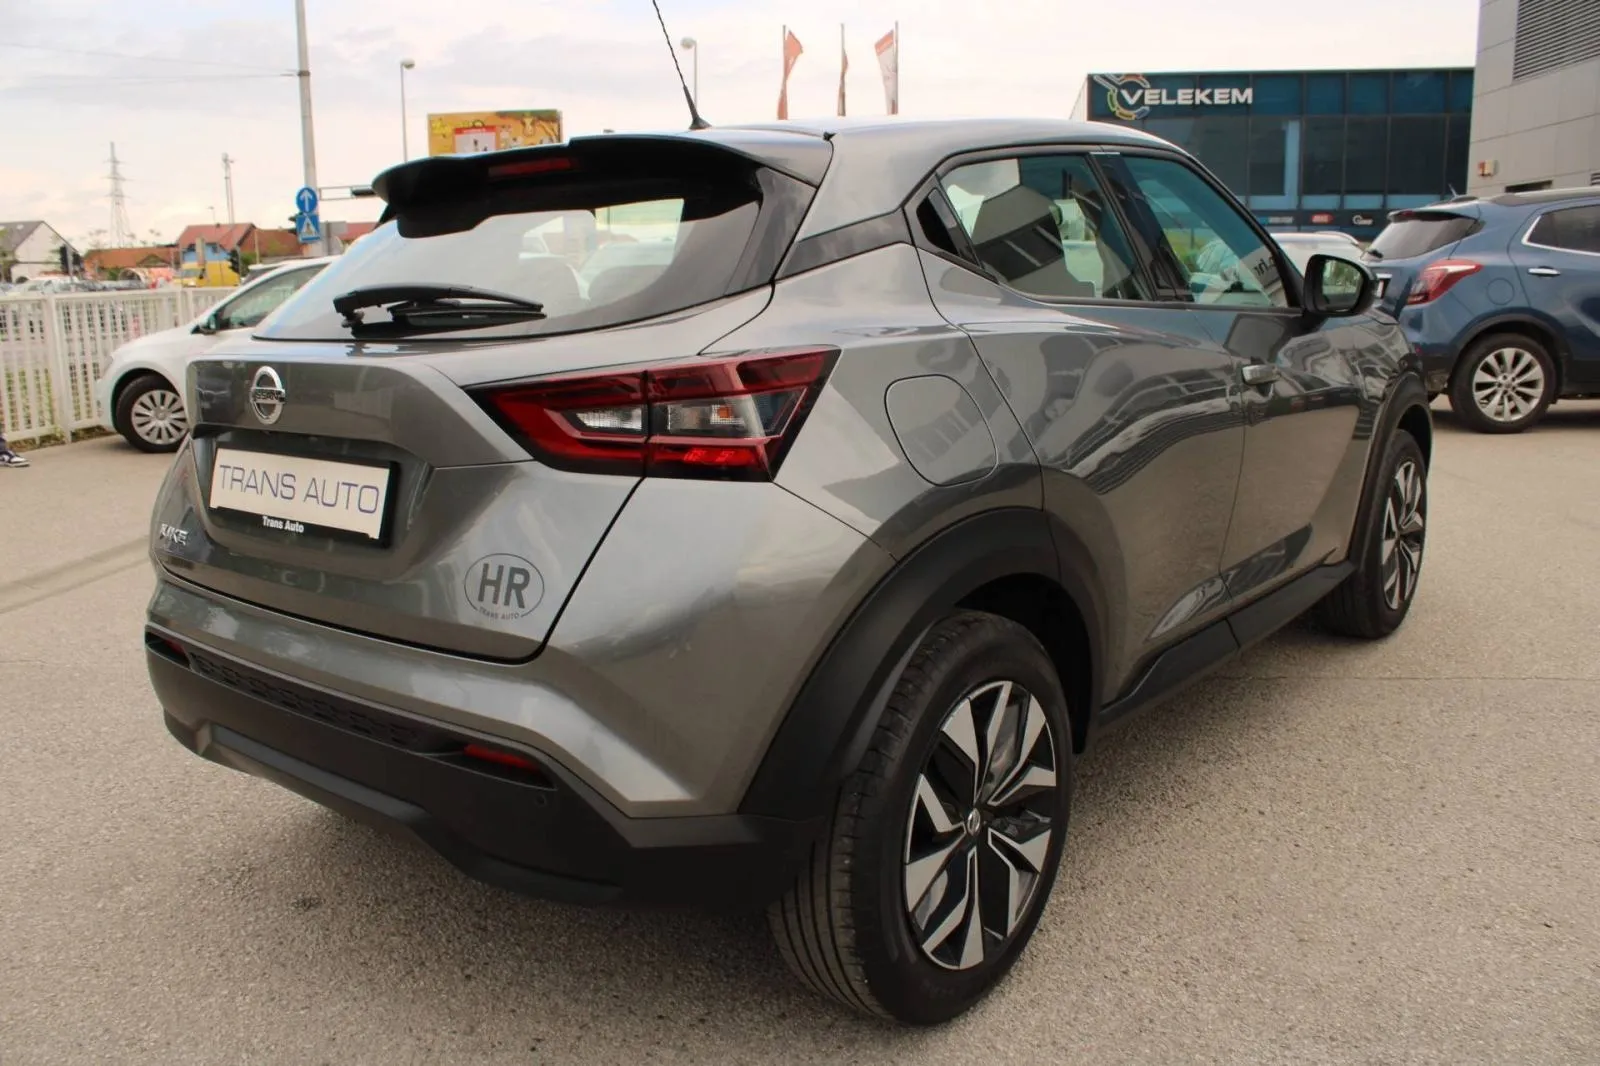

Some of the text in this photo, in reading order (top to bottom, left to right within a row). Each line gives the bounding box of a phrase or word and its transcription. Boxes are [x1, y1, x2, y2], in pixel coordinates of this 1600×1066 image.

[1120, 87, 1254, 106] VELEKEM
[219, 464, 380, 514] TRANS AUTO
[262, 515, 305, 534] Trans Auto
[477, 562, 530, 609] HR
[500, 612, 520, 620] AUTO
